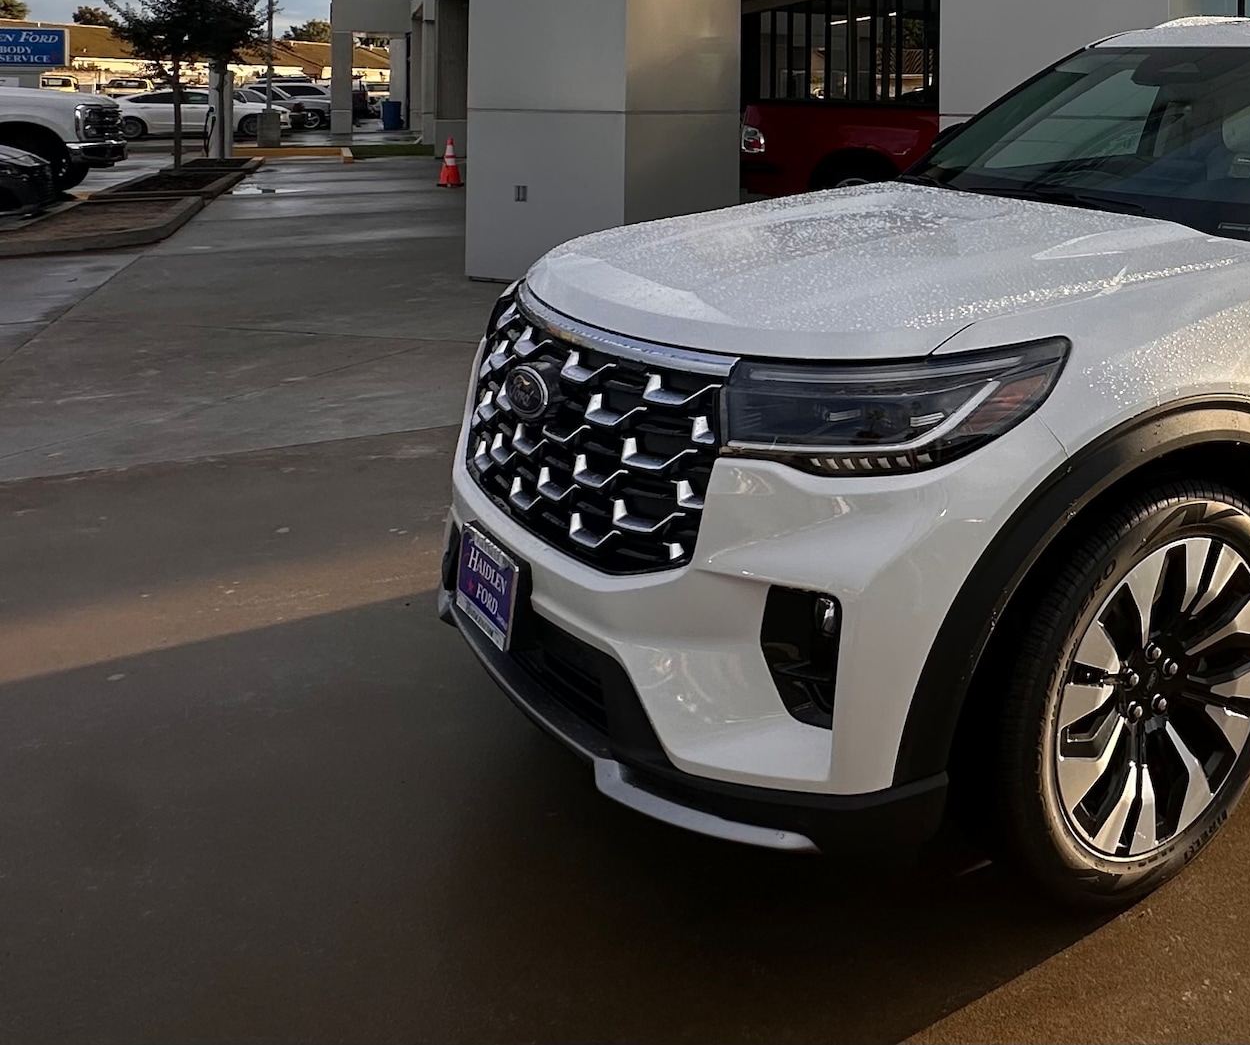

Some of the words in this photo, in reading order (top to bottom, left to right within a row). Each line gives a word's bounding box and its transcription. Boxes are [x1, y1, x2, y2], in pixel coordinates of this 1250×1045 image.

[18, 31, 59, 43] FORD
[0, 45, 33, 54] BODY
[0, 55, 51, 63] SERVICE
[467, 546, 508, 596] HAIDLEN
[475, 582, 499, 615] FORD
[1183, 809, 1229, 861] PIRELLI
